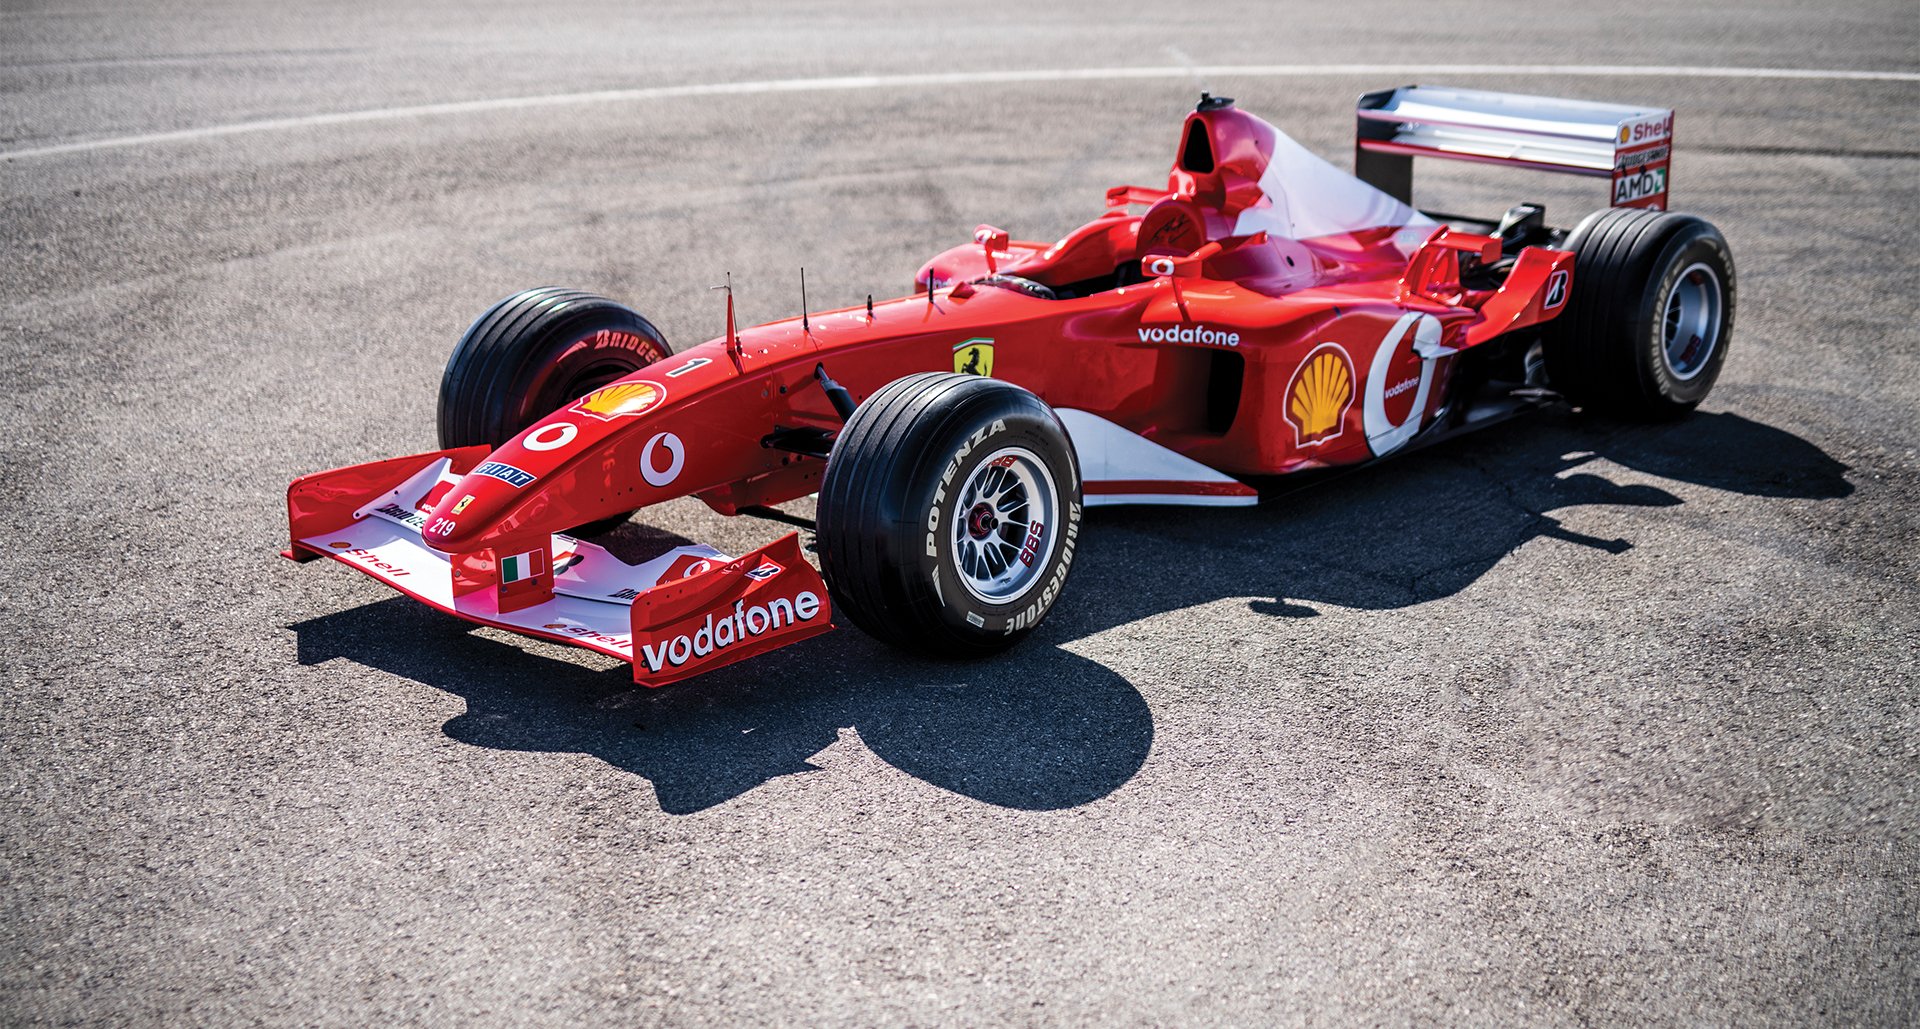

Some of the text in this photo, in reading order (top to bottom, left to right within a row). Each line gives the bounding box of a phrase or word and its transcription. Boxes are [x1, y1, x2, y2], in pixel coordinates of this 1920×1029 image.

[1615, 172, 1654, 201] AMD
[1137, 324, 1241, 347] vodafone
[665, 357, 713, 378] 1
[1384, 376, 1420, 399] vodafone
[478, 461, 530, 485] FIAT
[926, 418, 1007, 557] POTENZA
[375, 503, 425, 530] BRIDGE
[429, 517, 456, 536] 219
[1019, 520, 1045, 568] BBS
[345, 548, 411, 577] Shell
[1004, 500, 1081, 636] BRIDGESTONE
[641, 591, 820, 672] vodafone
